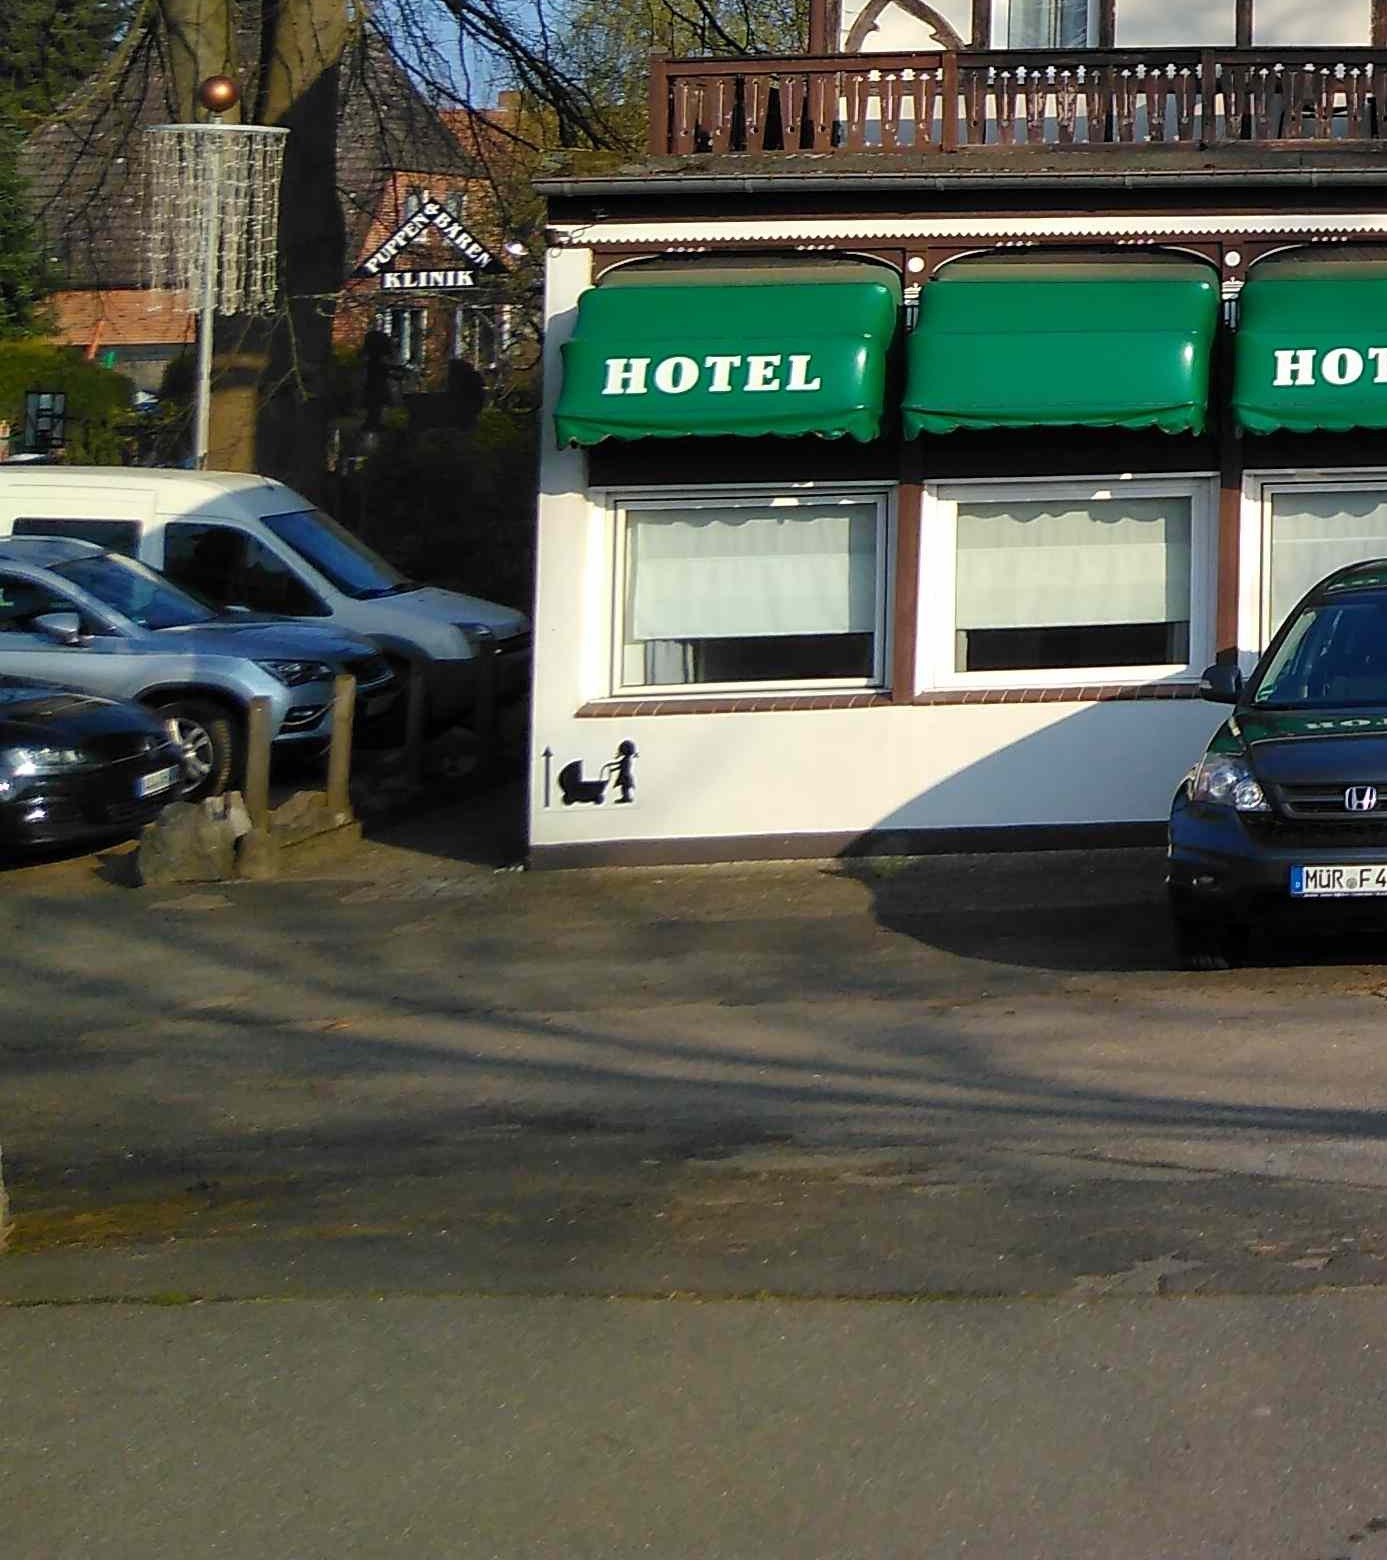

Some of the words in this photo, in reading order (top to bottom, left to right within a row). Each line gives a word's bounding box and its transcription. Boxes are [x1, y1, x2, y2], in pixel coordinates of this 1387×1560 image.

[364, 212, 430, 274] PUPPEN
[423, 202, 441, 216] &
[382, 269, 475, 289] KLINIK
[601, 353, 822, 395] HOTEL
[1359, 868, 1372, 888] F
